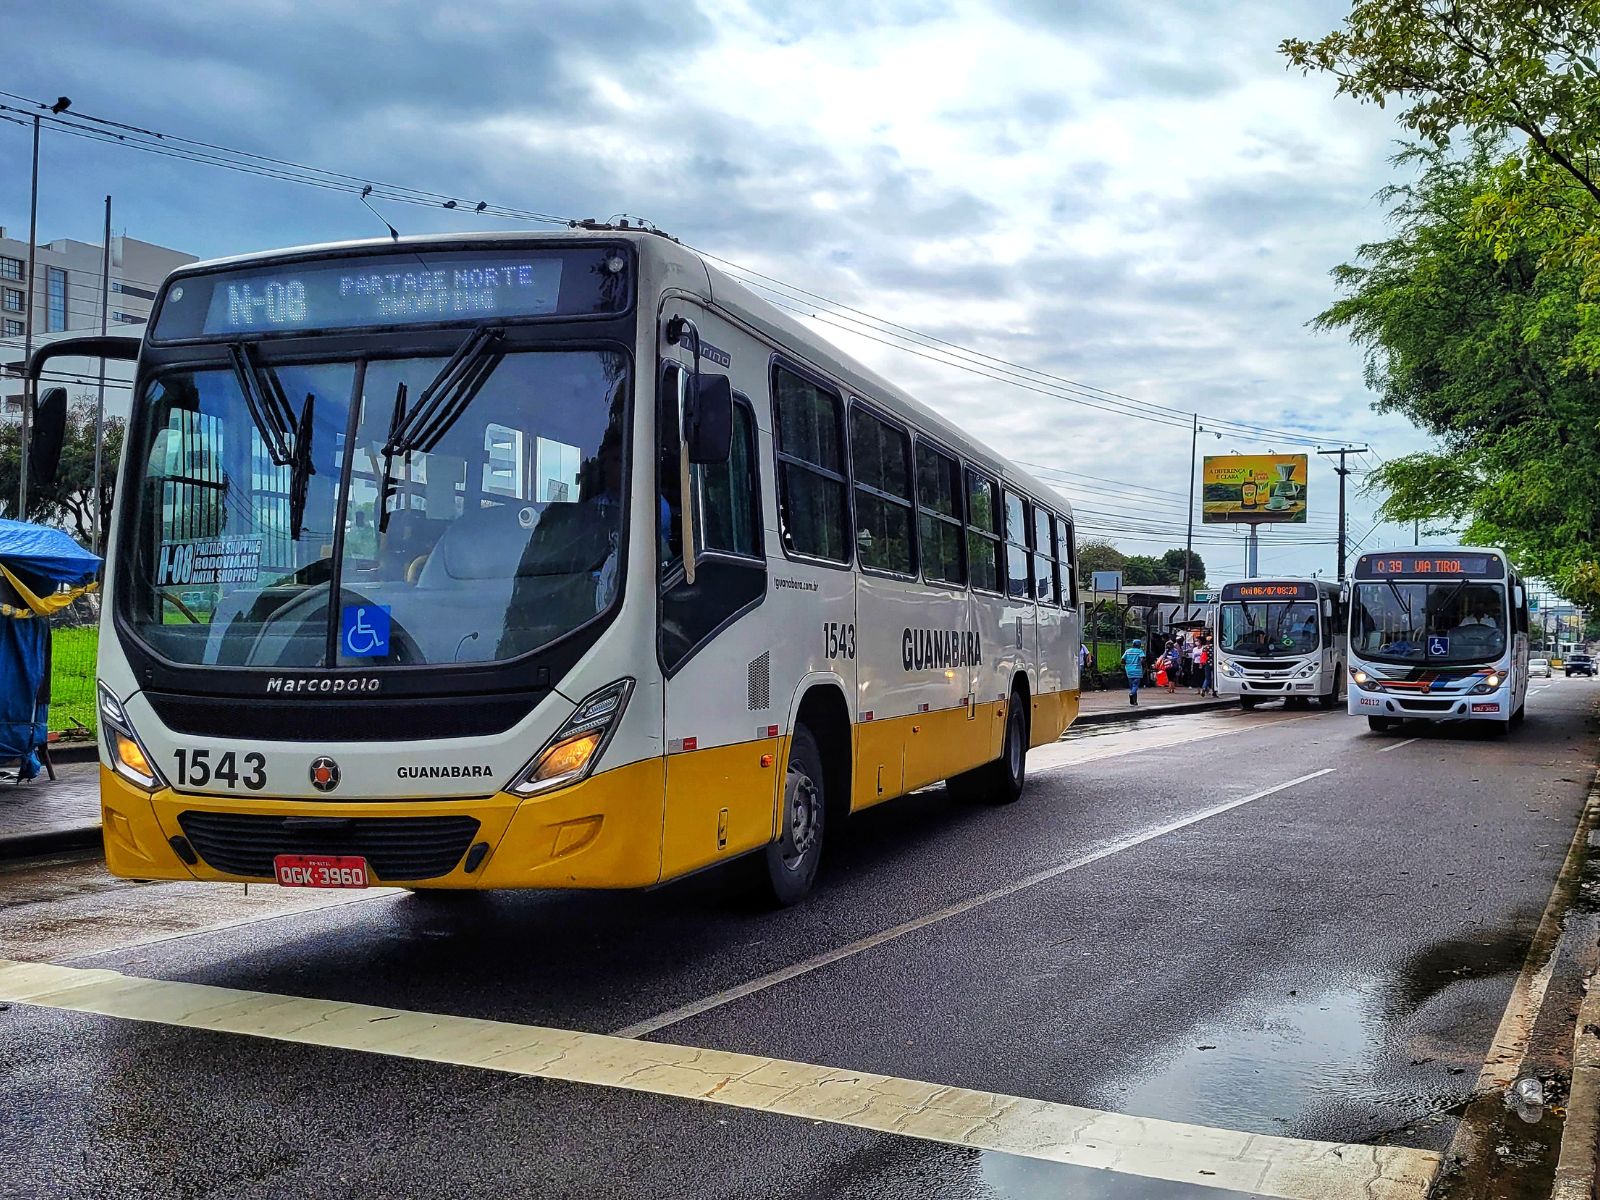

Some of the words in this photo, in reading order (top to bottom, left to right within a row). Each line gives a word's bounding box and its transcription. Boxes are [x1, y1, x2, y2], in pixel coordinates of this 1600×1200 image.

[340, 270, 447, 296] PARTAGE
[453, 264, 535, 289] NORTE
[228, 280, 307, 325] N-08
[377, 289, 496, 316] SHOPPING
[195, 542, 225, 556] PARTAGE
[225, 540, 262, 554] SHOPPING
[157, 544, 194, 585] N-08
[192, 570, 215, 584] NATAL
[216, 568, 258, 583] SHOPPING
[1388, 560, 1402, 573] 39
[1414, 560, 1431, 573] VIA
[1435, 560, 1464, 573] TIROL
[823, 622, 856, 660] 1543
[902, 627, 982, 671] GUANABARA
[266, 677, 380, 693] Marcopolo
[1360, 697, 1380, 706] 02112
[173, 748, 267, 791] 1543
[397, 765, 493, 779] GUANABARA
